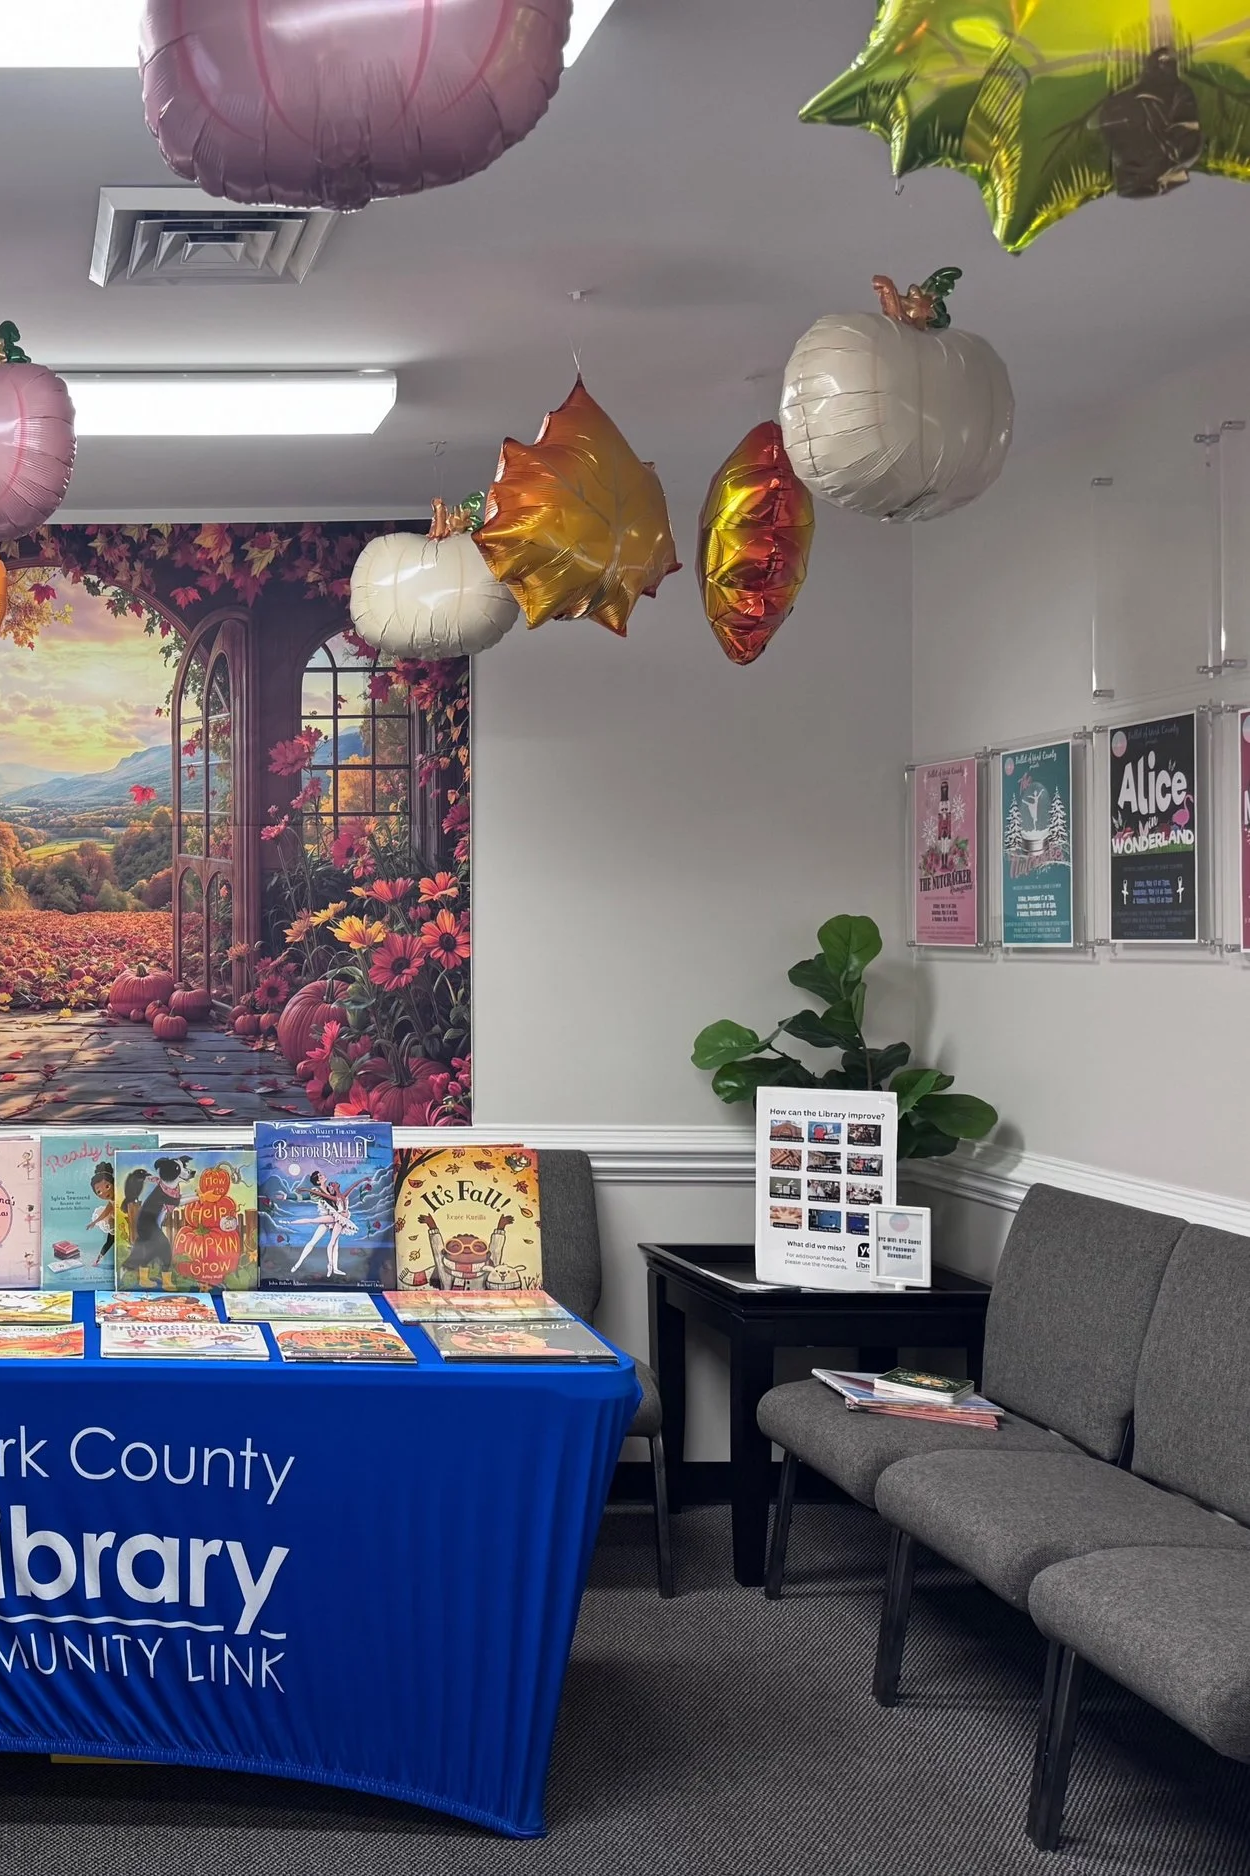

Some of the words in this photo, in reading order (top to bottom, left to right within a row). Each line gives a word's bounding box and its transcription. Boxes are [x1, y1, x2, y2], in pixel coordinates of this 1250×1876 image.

[1117, 750, 1187, 815] Alice
[1111, 829, 1195, 855] WONDERLAND
[919, 877, 931, 892] THE
[932, 869, 972, 891] NUTCRACKER
[803, 1109, 817, 1117] the
[818, 1110, 846, 1120] Library
[848, 1112, 885, 1120] improve?
[46, 1138, 103, 1174] Ready
[273, 1140, 288, 1160] B
[291, 1146, 300, 1157] IS
[301, 1146, 320, 1158] FOR
[322, 1134, 375, 1160] BALLET
[205, 1176, 226, 1186] How
[420, 1184, 454, 1213] It's
[456, 1180, 512, 1213] Fall!
[190, 1206, 227, 1224] Help
[175, 1233, 239, 1260] PUMPKIN
[787, 1240, 804, 1248] What
[190, 1259, 231, 1275] Grow
[795, 1252, 821, 1260] additional
[821, 1255, 847, 1263] feedback,
[821, 1262, 848, 1270] notecards.
[69, 1426, 295, 1506] County
[185, 1638, 287, 1693] LINK
